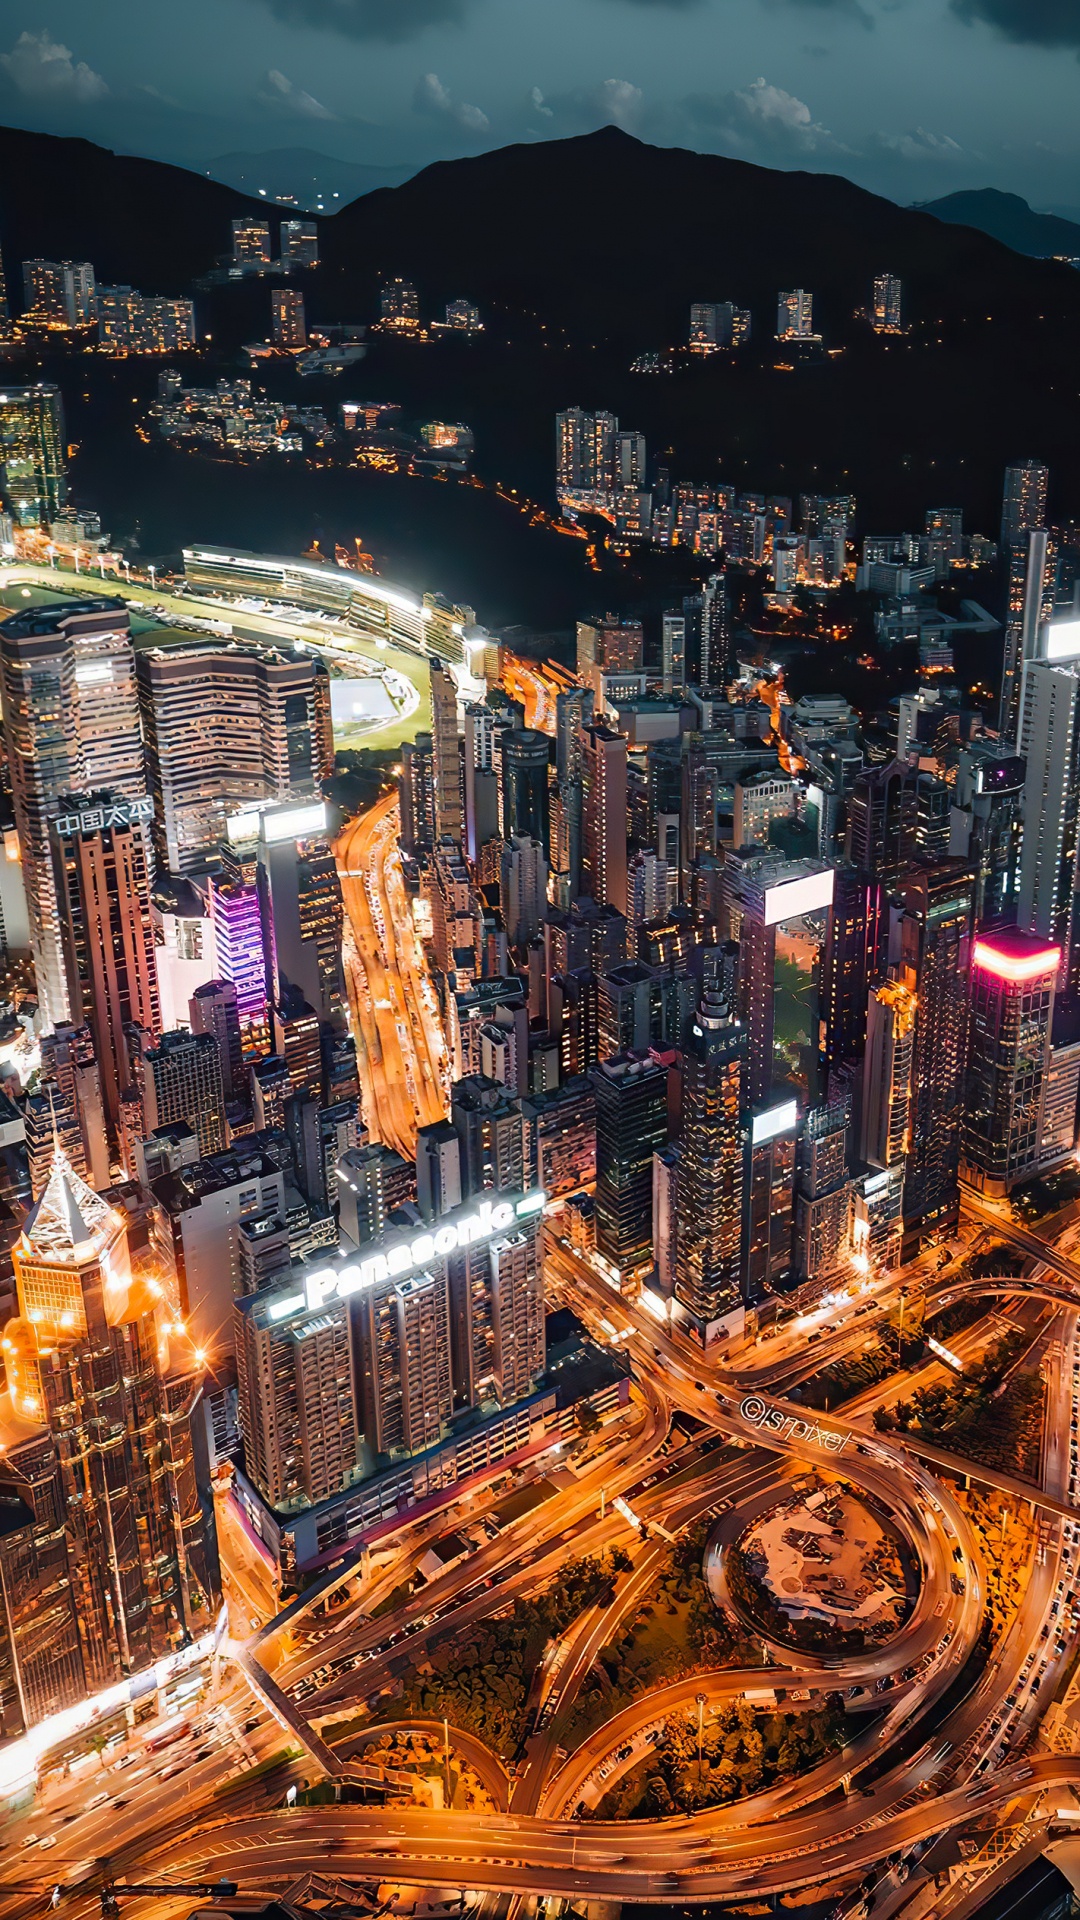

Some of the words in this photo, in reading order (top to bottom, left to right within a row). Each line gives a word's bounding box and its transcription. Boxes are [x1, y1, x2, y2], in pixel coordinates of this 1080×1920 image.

[53, 799, 151, 835] 中国太平
[305, 1201, 514, 1311] Panasonic
